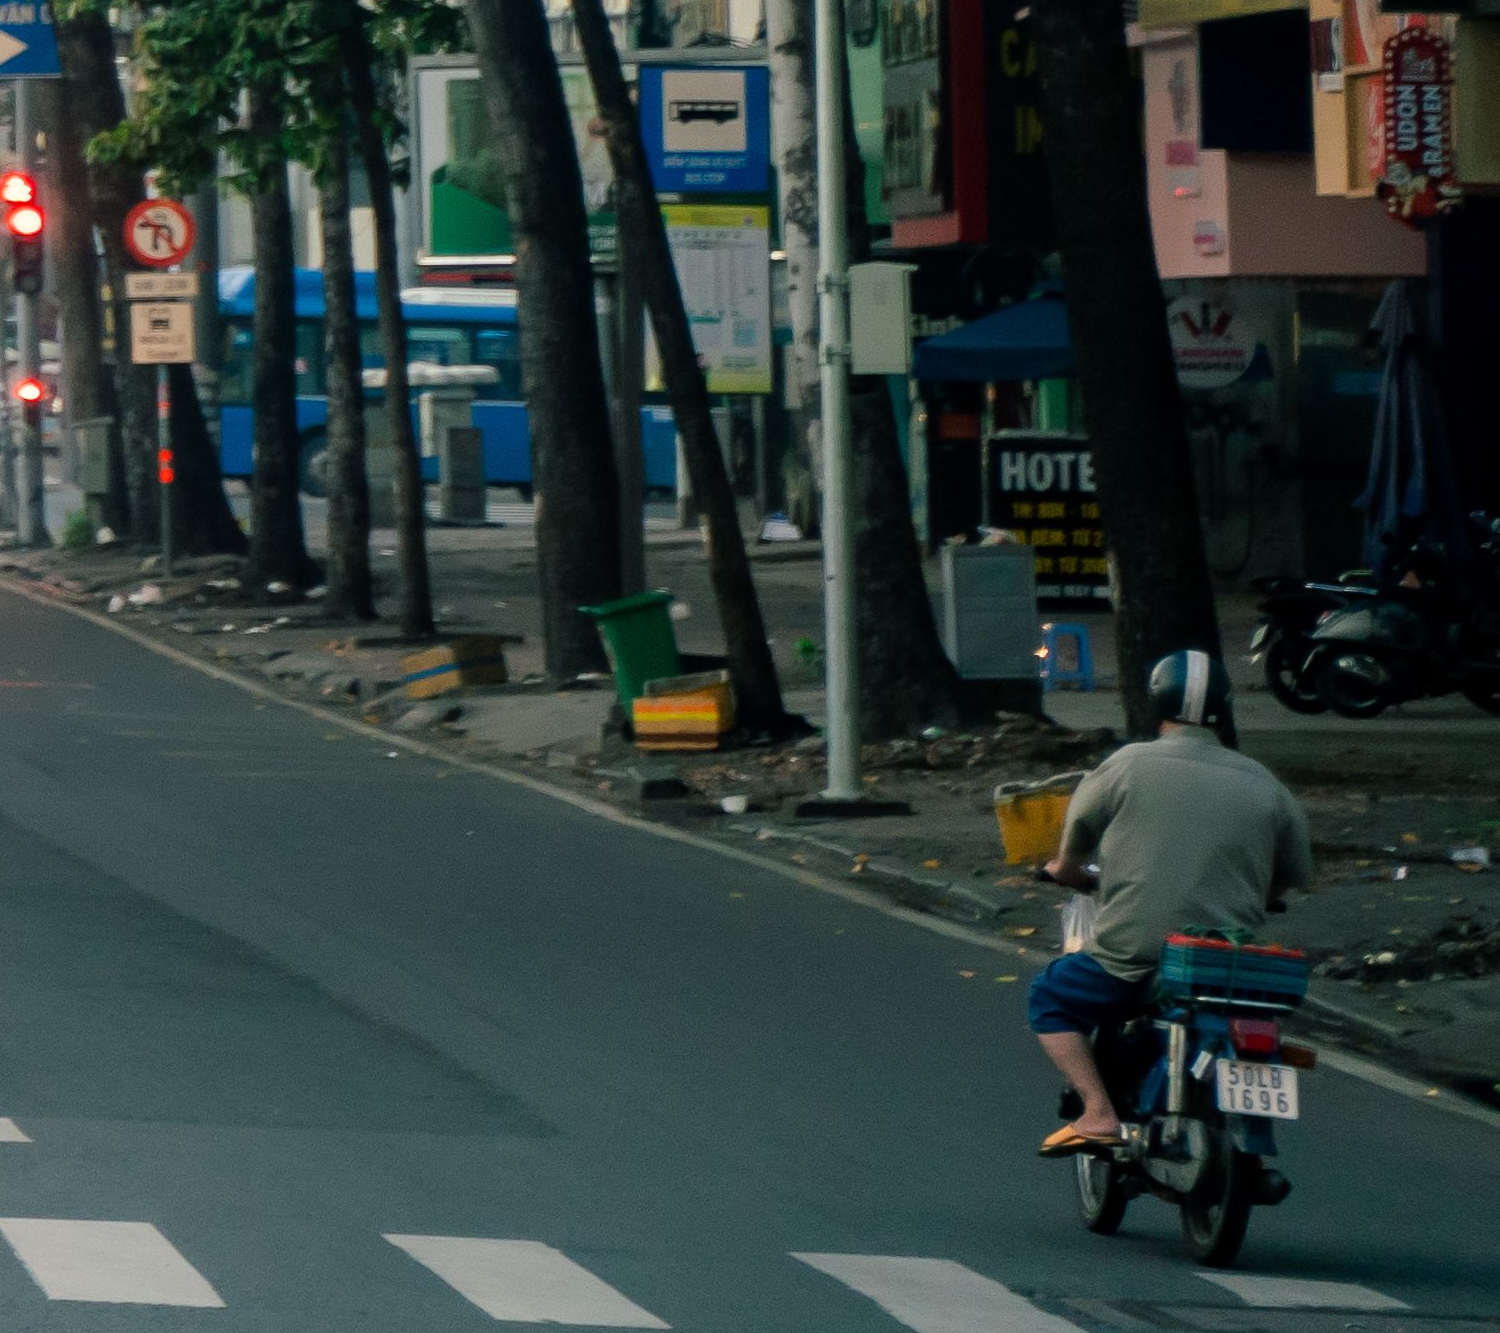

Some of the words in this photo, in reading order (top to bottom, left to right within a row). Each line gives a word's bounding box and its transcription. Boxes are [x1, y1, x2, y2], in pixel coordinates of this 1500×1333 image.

[1395, 84, 1419, 152] UDON
[1421, 83, 1443, 166] RAMEN
[1228, 1086, 1289, 1114] 1696
